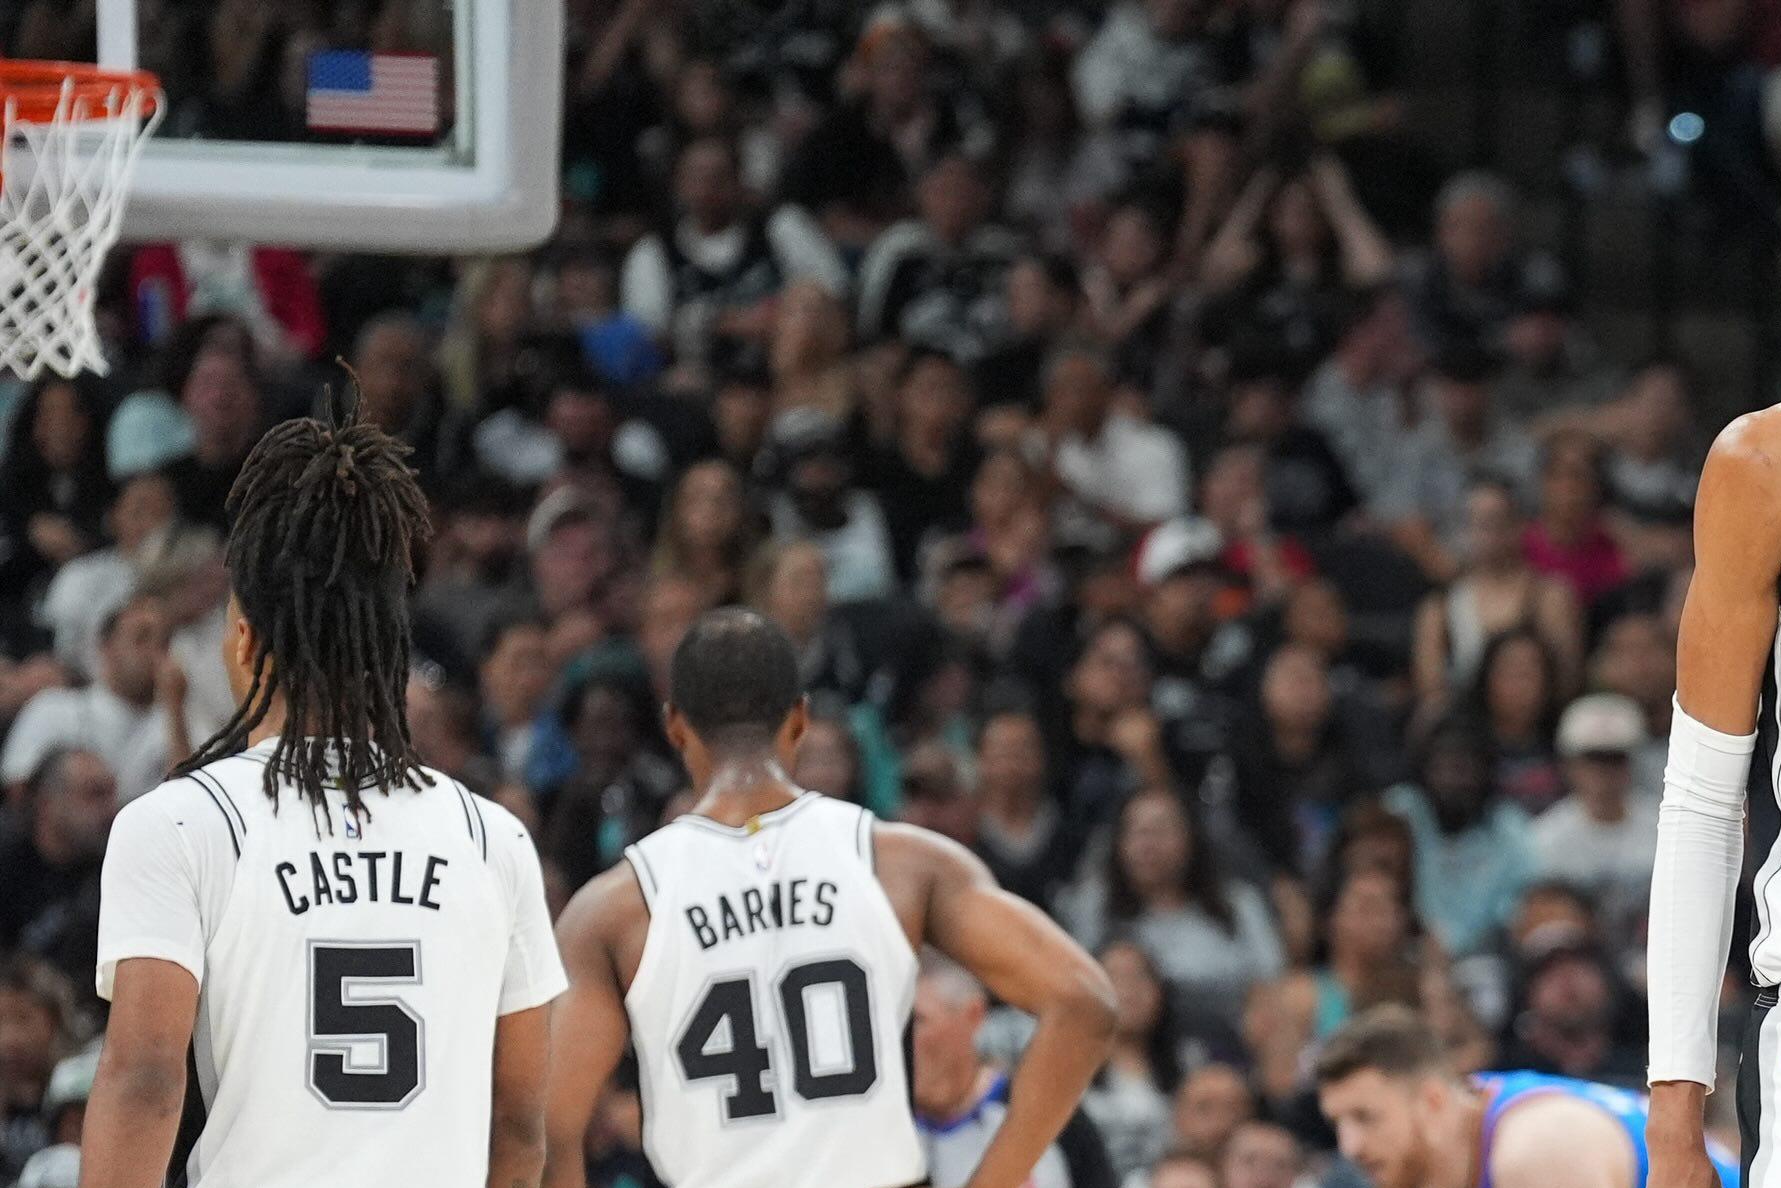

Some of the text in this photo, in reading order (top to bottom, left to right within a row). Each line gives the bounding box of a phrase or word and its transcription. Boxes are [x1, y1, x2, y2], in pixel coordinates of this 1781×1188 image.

[275, 851, 448, 915] CASTLE
[304, 938, 426, 1110] 5
[672, 954, 881, 1123] 40
